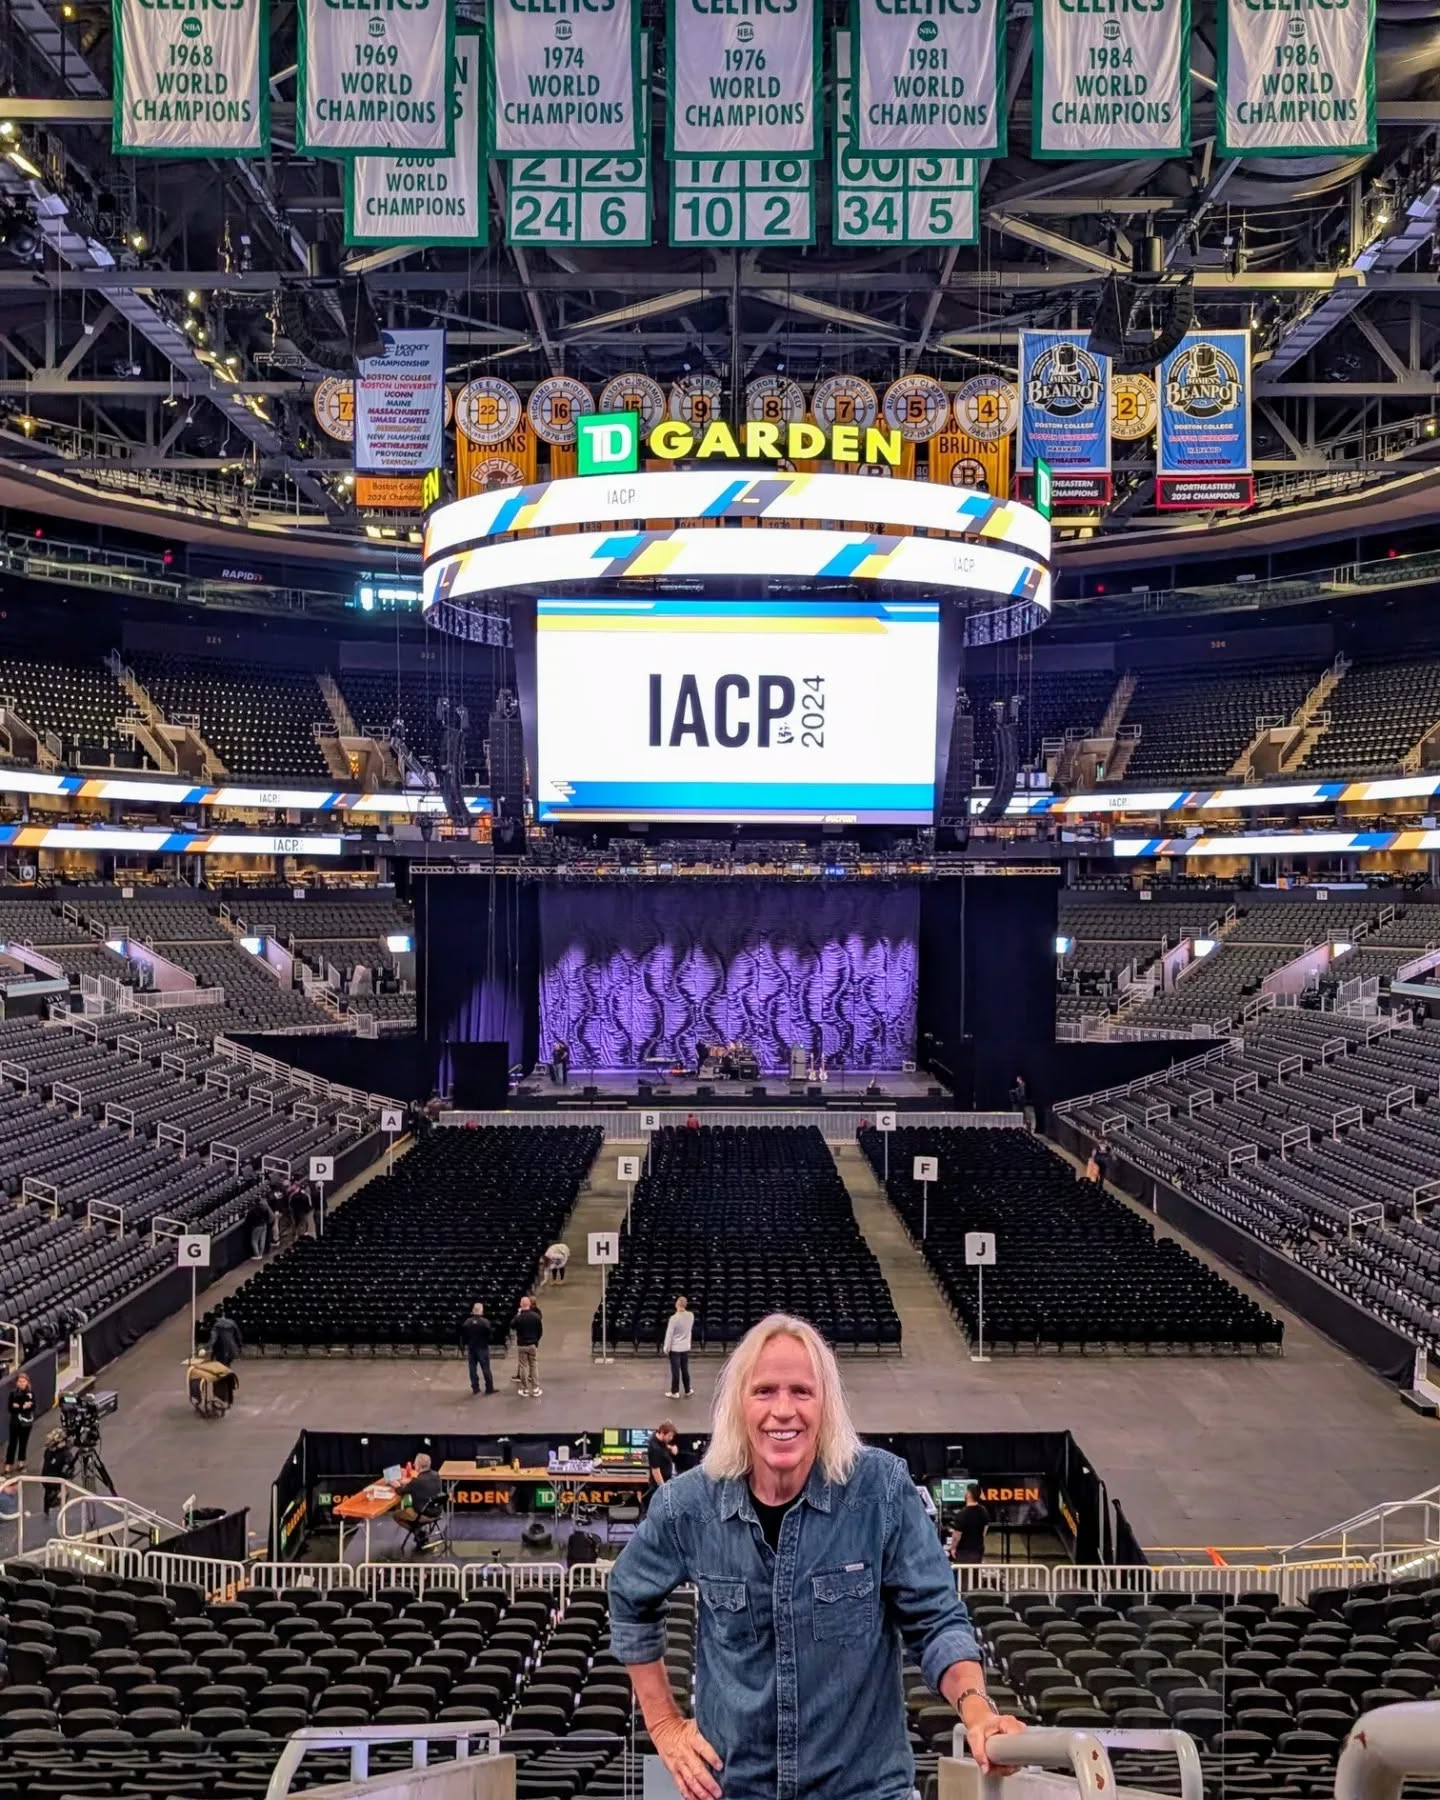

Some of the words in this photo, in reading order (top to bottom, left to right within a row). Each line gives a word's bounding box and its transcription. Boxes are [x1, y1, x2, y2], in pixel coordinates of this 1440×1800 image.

[369, 23, 385, 32] NBA
[556, 26, 572, 35] NBA
[737, 28, 754, 37] NBA
[919, 27, 937, 35] NBA
[1104, 26, 1120, 36] NBA
[1288, 24, 1305, 33] NBA
[169, 45, 213, 66] 1968
[355, 45, 398, 66] 1969
[544, 47, 584, 69] 1974
[725, 49, 766, 71] 1976
[909, 48, 948, 70] 1981
[1089, 47, 1133, 69] 1984
[1275, 44, 1319, 67] 1986
[157, 72, 228, 95] WORLD
[342, 72, 412, 95] WORLD
[528, 75, 600, 97] WORLD
[709, 76, 781, 99] WORLD
[893, 76, 964, 98] WORLD
[1076, 74, 1147, 97] WORLD
[1262, 72, 1333, 96] WORLD
[133, 99, 250, 122] CHAMPIONS
[316, 99, 436, 123] CHAMPIONS
[504, 102, 624, 124] CHAMPIONS
[685, 102, 804, 127] CHAMPIONS
[869, 103, 987, 126] CHAMPIONS
[1052, 101, 1171, 124] CHAMPIONS
[1237, 98, 1357, 123] CHAMPIONS
[585, 158, 643, 182] 25
[386, 173, 448, 192] WORLD
[366, 197, 466, 216] CHAMPIONS
[514, 196, 572, 236] 24
[600, 197, 627, 236] 6
[843, 195, 898, 235] 34
[928, 197, 954, 234] 5
[682, 196, 733, 237] 10
[764, 196, 791, 236] 2
[360, 382, 392, 390] BOSTON
[636, 379, 662, 409] SCHMIDT
[960, 379, 988, 401] ROBERT
[1001, 384, 1016, 401] ORR
[1026, 379, 1104, 405] BEANPOT
[1165, 381, 1242, 407] BEANPOT
[531, 385, 550, 420] RICHARD
[563, 381, 593, 416] MIDDLETO
[695, 400, 708, 418] 9
[766, 400, 779, 418] 8
[839, 401, 852, 418] 7
[909, 401, 923, 418] 5
[981, 400, 995, 418] 4
[1121, 397, 1134, 415] 2
[370, 416, 397, 424] UMASS
[480, 405, 496, 416] 22
[554, 403, 568, 419] 16
[367, 433, 385, 441] NEW
[387, 433, 430, 441] HAMPSHIRE
[583, 423, 632, 464] TD
[650, 420, 902, 466] GARDEN
[940, 436, 998, 454] BRUINS
[472, 459, 523, 481] BOSTON
[607, 488, 635, 505] IACP
[1176, 483, 1236, 491] NORTHEASTERN
[1193, 492, 1240, 500] CHAMPIONS
[648, 673, 795, 749] IACP
[801, 675, 825, 748] 2024
[273, 839, 299, 851] IACP
[386, 1116, 397, 1126] A
[645, 1115, 654, 1125] B
[881, 1116, 891, 1126] C
[315, 1163, 327, 1174] D
[623, 1163, 632, 1174] E
[920, 1162, 930, 1174] F
[187, 1243, 202, 1257] G
[596, 1241, 610, 1256] H
[975, 1241, 986, 1256] J
[449, 1490, 510, 1504] ARDEN
[979, 1487, 1040, 1501] ARDEN
